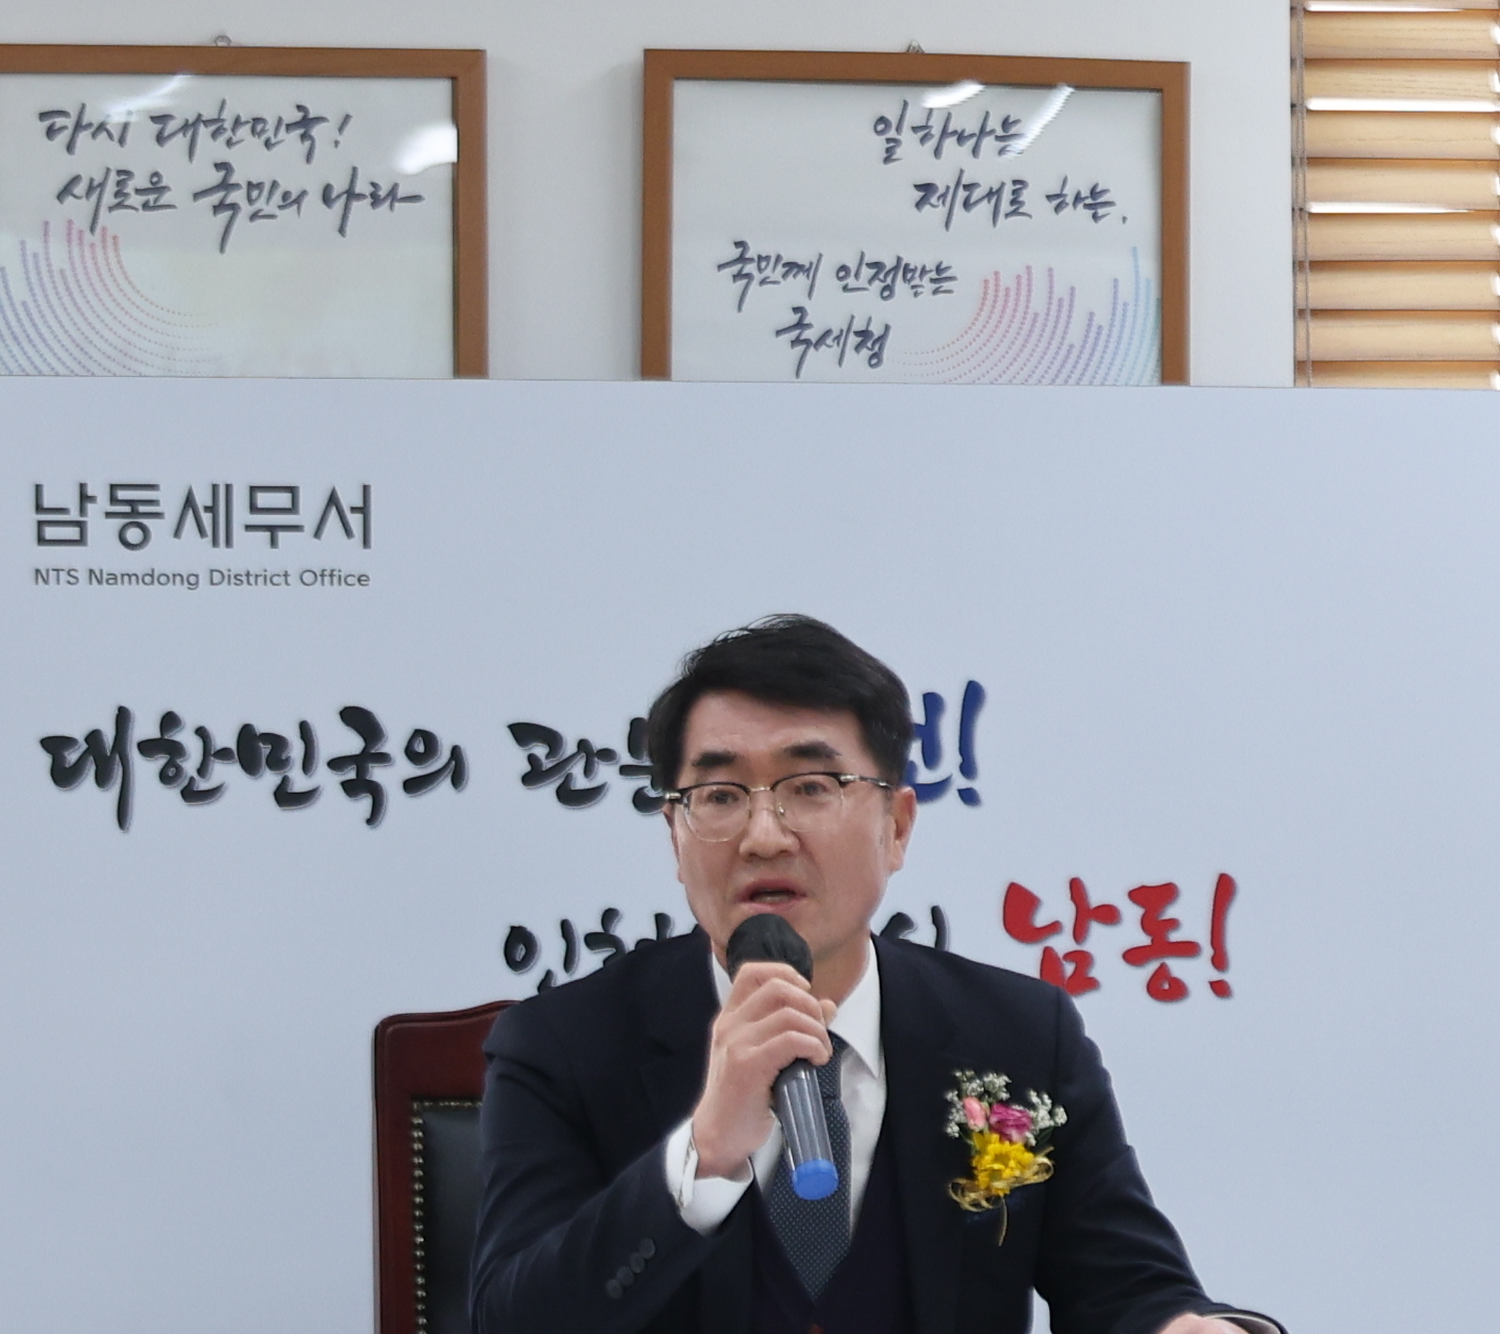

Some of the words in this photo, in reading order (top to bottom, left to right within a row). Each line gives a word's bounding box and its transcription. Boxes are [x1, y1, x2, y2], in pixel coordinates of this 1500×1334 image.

[38, 102, 133, 156] 다시
[149, 98, 353, 164] 대한민국!
[873, 99, 909, 166] 일
[911, 108, 1025, 161] 하나는
[55, 166, 179, 237] 새로운
[192, 160, 308, 254] 국민의
[321, 165, 426, 238] 나라
[912, 167, 1033, 232] 제대로
[716, 239, 824, 313] 국민께
[835, 250, 959, 302] 인정받는
[774, 305, 892, 380] 국세청
[33, 482, 373, 551] 남동세무서
[33, 567, 80, 587] NTS
[87, 567, 201, 591] Namdong
[208, 567, 292, 588] District
[298, 567, 372, 588] Office
[38, 705, 469, 833] 대한민국의
[1001, 872, 1238, 1003] 남동!
